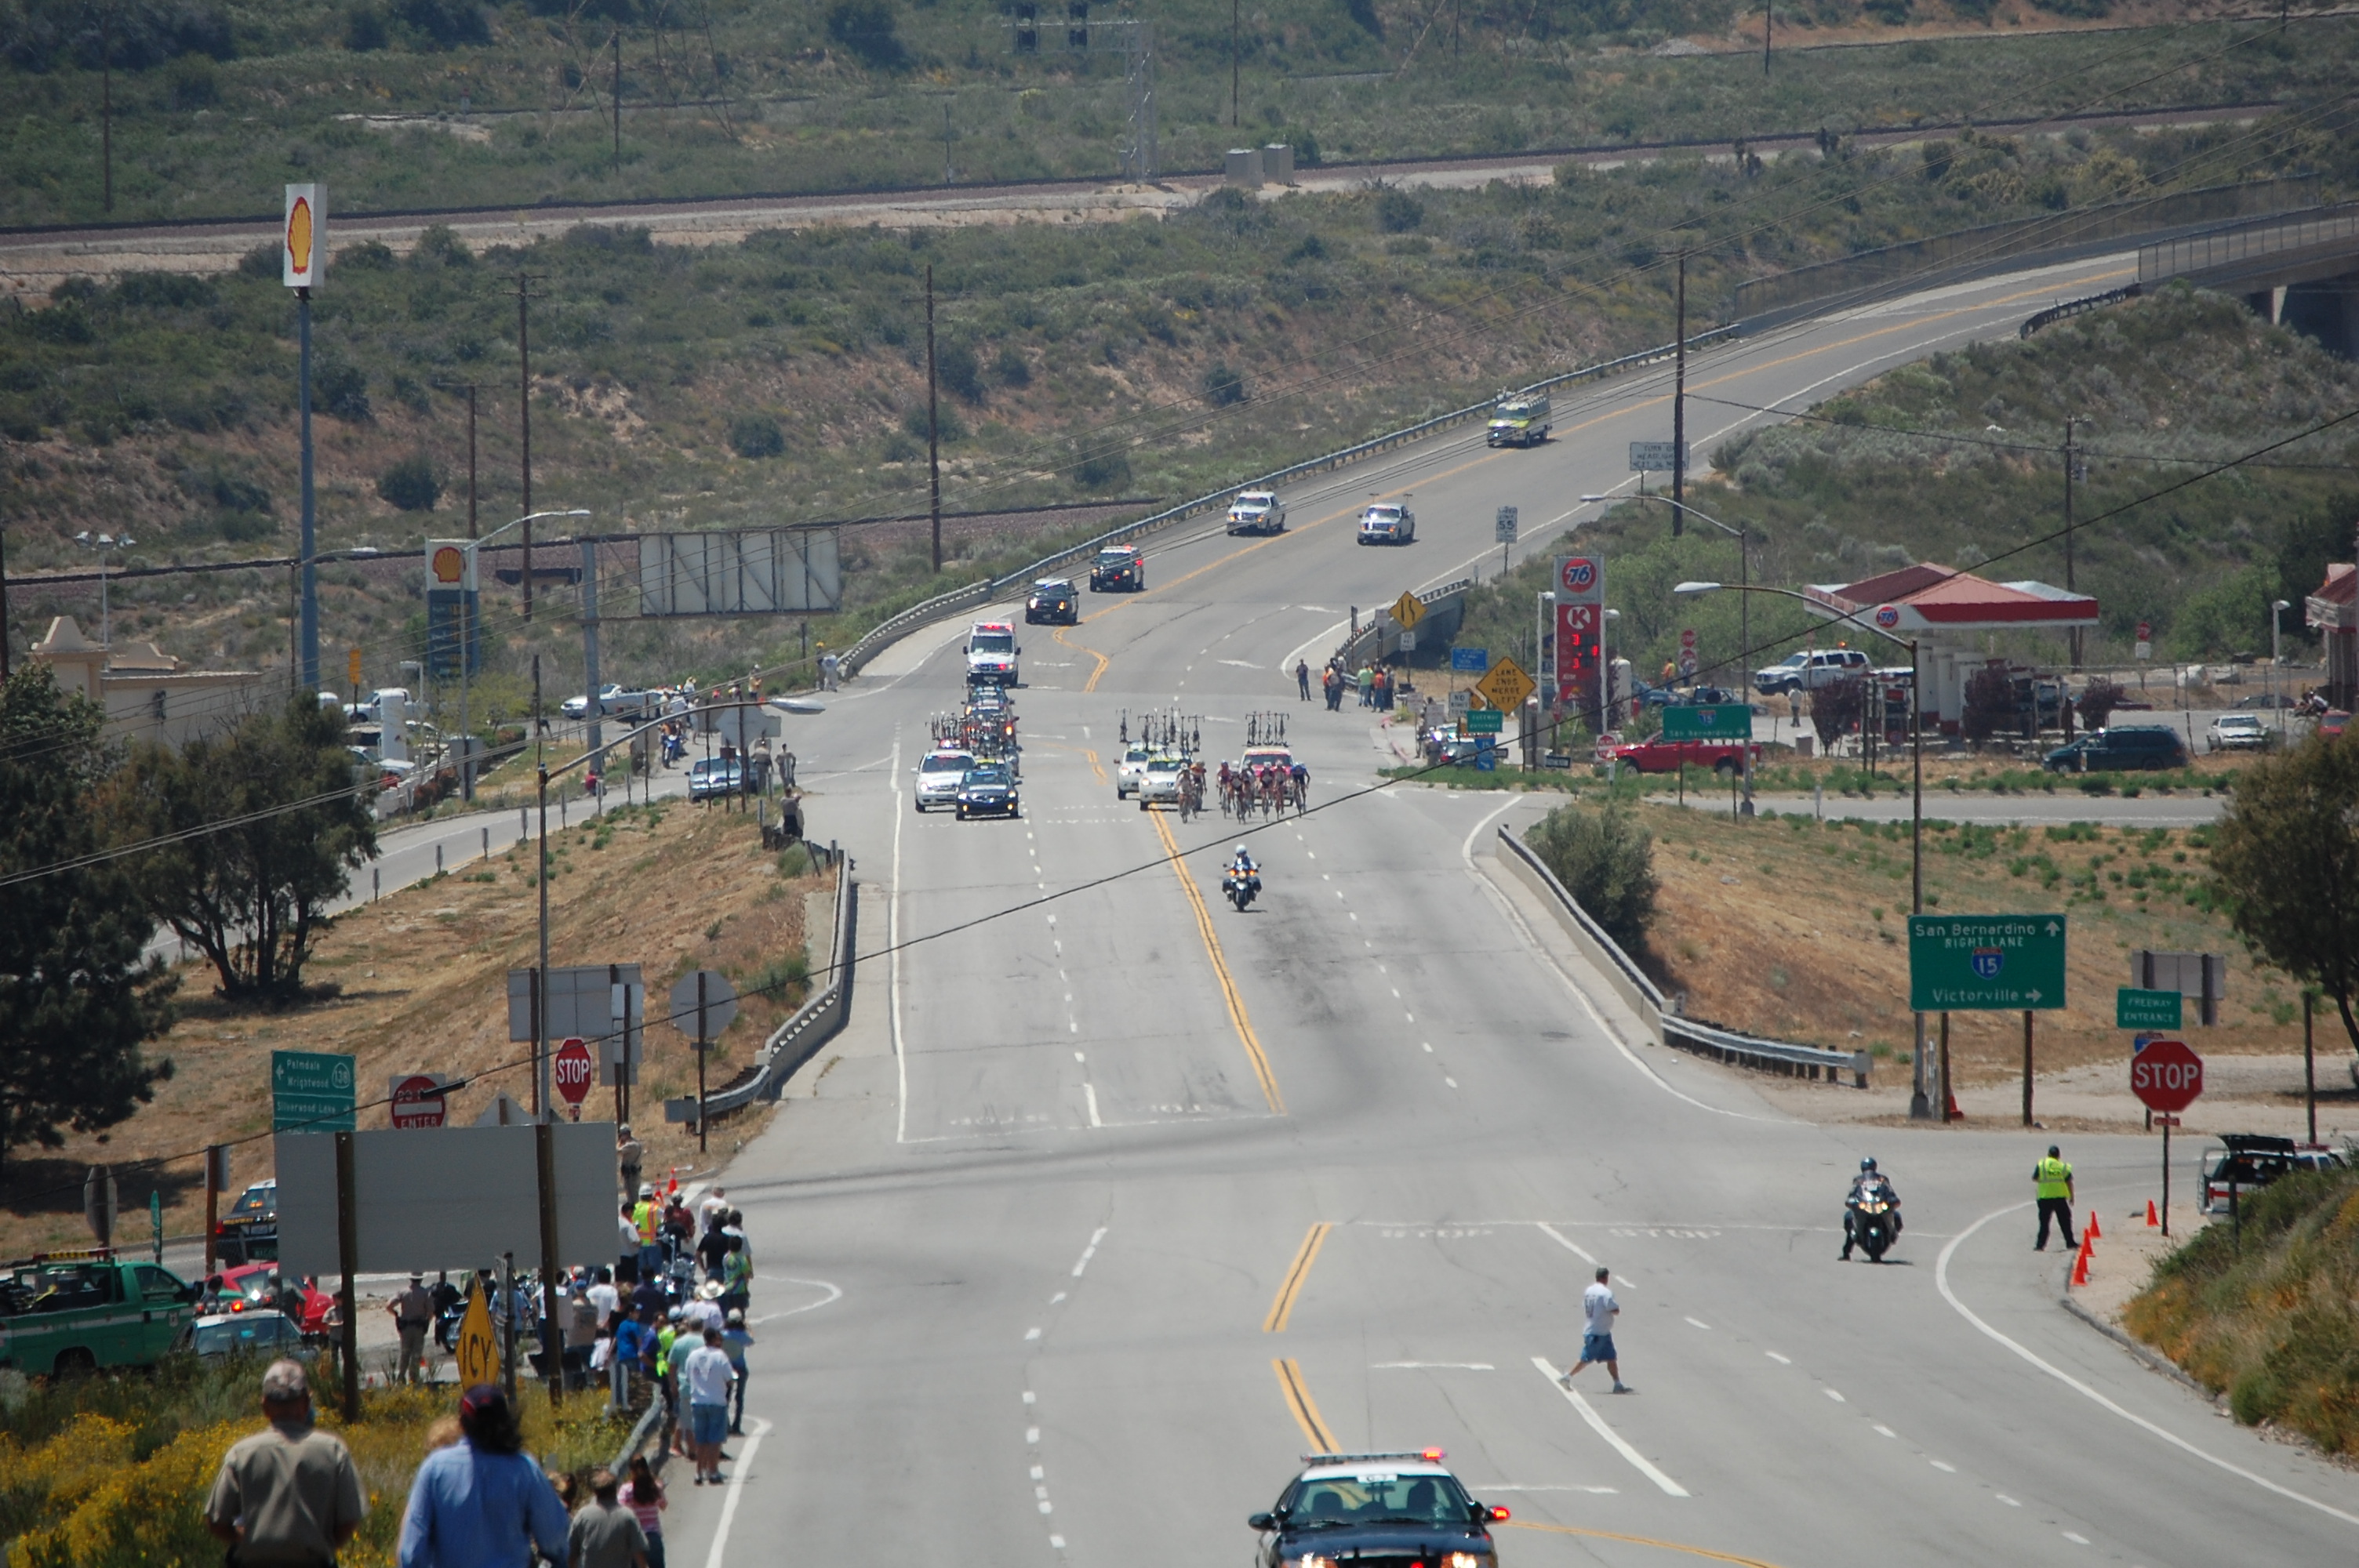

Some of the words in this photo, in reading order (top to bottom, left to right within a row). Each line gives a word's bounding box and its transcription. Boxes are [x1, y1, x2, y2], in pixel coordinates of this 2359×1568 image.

[1566, 564, 1591, 585] 76
[1567, 606, 1590, 630] K
[1879, 611, 1896, 624] 76
[1915, 924, 1946, 937] San
[1952, 923, 2036, 936] Bernardino
[1945, 938, 1983, 949] RIGHT
[1991, 937, 2024, 948] LANE
[1979, 957, 1998, 974] 15
[1932, 989, 2019, 1003] Victorville
[2128, 997, 2172, 1007] FREEWAY
[2124, 1012, 2175, 1023] ENTRANCE
[286, 1059, 321, 1072] Palmdale
[558, 1058, 590, 1083] STOP
[334, 1069, 350, 1083] 138
[2135, 1062, 2199, 1090] STOP
[287, 1077, 330, 1090] Wrightwood
[277, 1102, 316, 1112] Silverwood
[401, 1116, 438, 1129] ENTER
[463, 1332, 492, 1381] ICY
